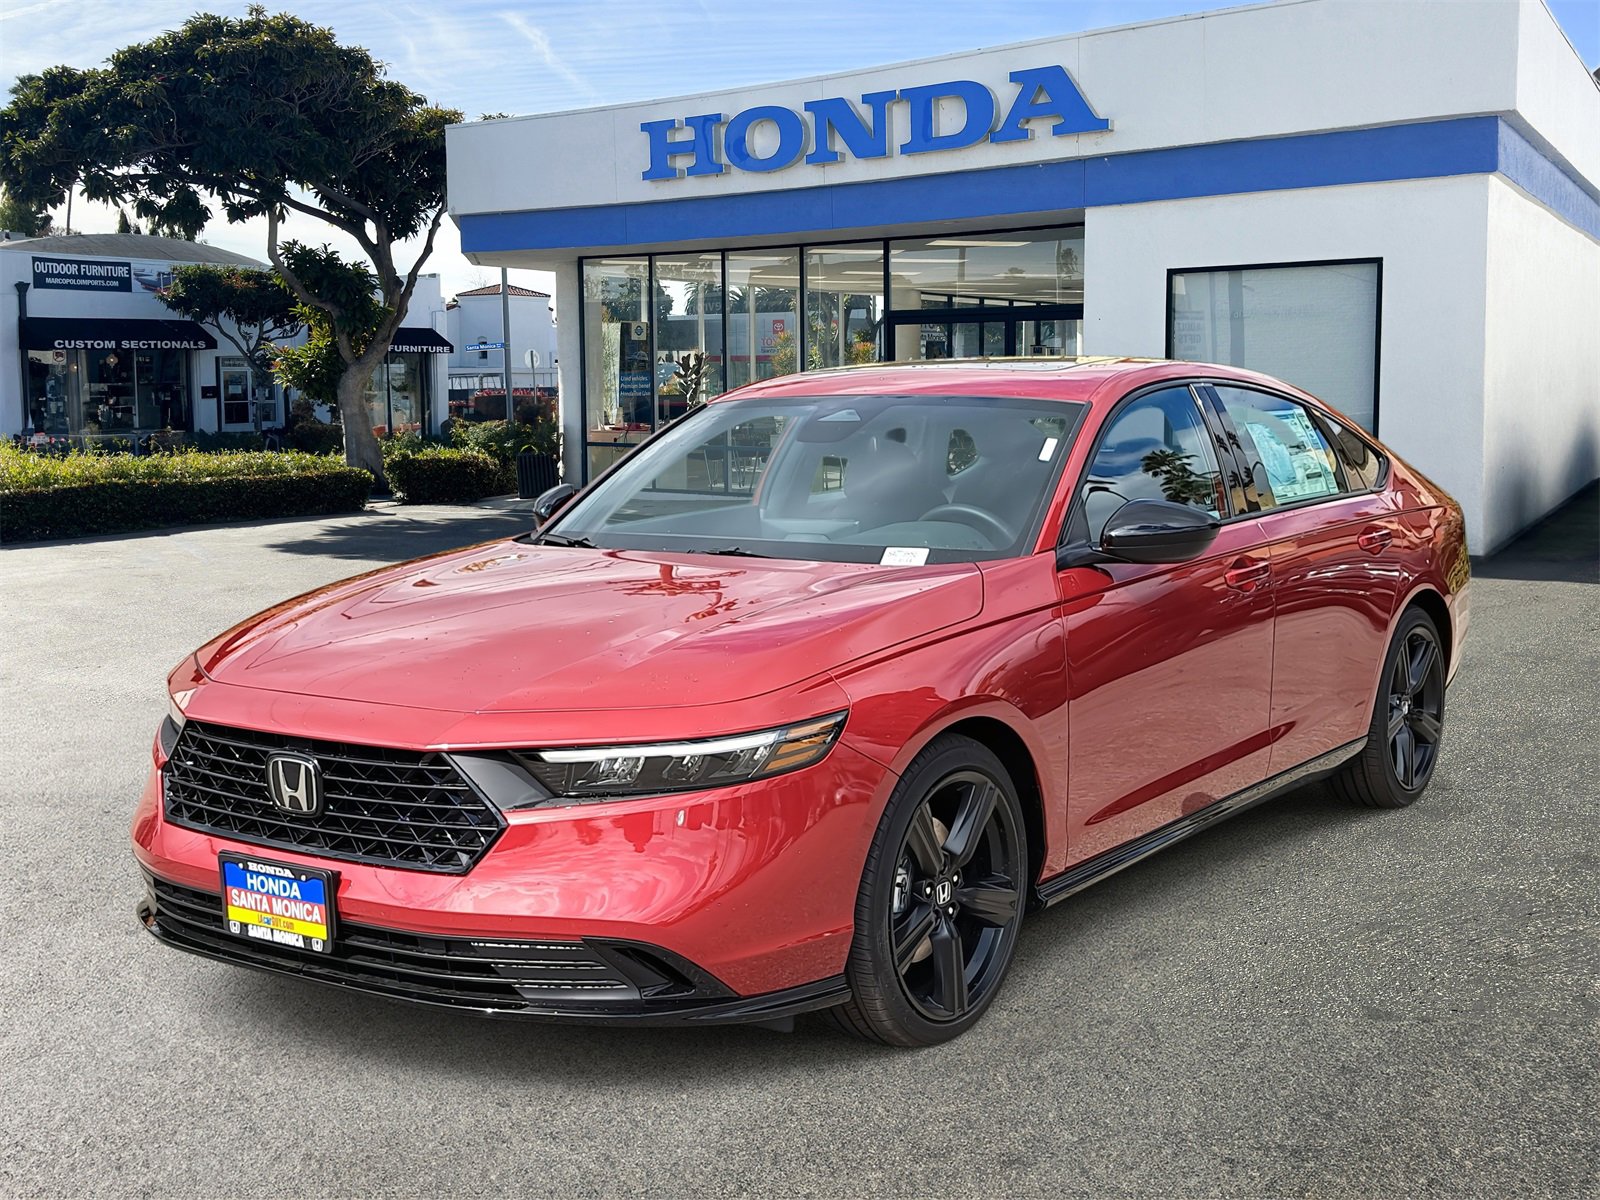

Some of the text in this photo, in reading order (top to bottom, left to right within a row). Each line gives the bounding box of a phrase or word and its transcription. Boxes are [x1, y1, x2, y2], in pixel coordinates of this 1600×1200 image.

[640, 64, 1113, 181] HONDA
[34, 261, 130, 278] OUTDOOR FURNITURE
[45, 277, 119, 287] MARCOPOLOIMPORTS.COM
[54, 339, 206, 349] CUSTOM SECTIONALS
[388, 344, 450, 353] FURNITURE
[247, 862, 295, 878] HONDA
[246, 872, 302, 899] HONDA
[231, 888, 322, 923] SANTA MONICA
[247, 923, 305, 948] SANTA MONICA
